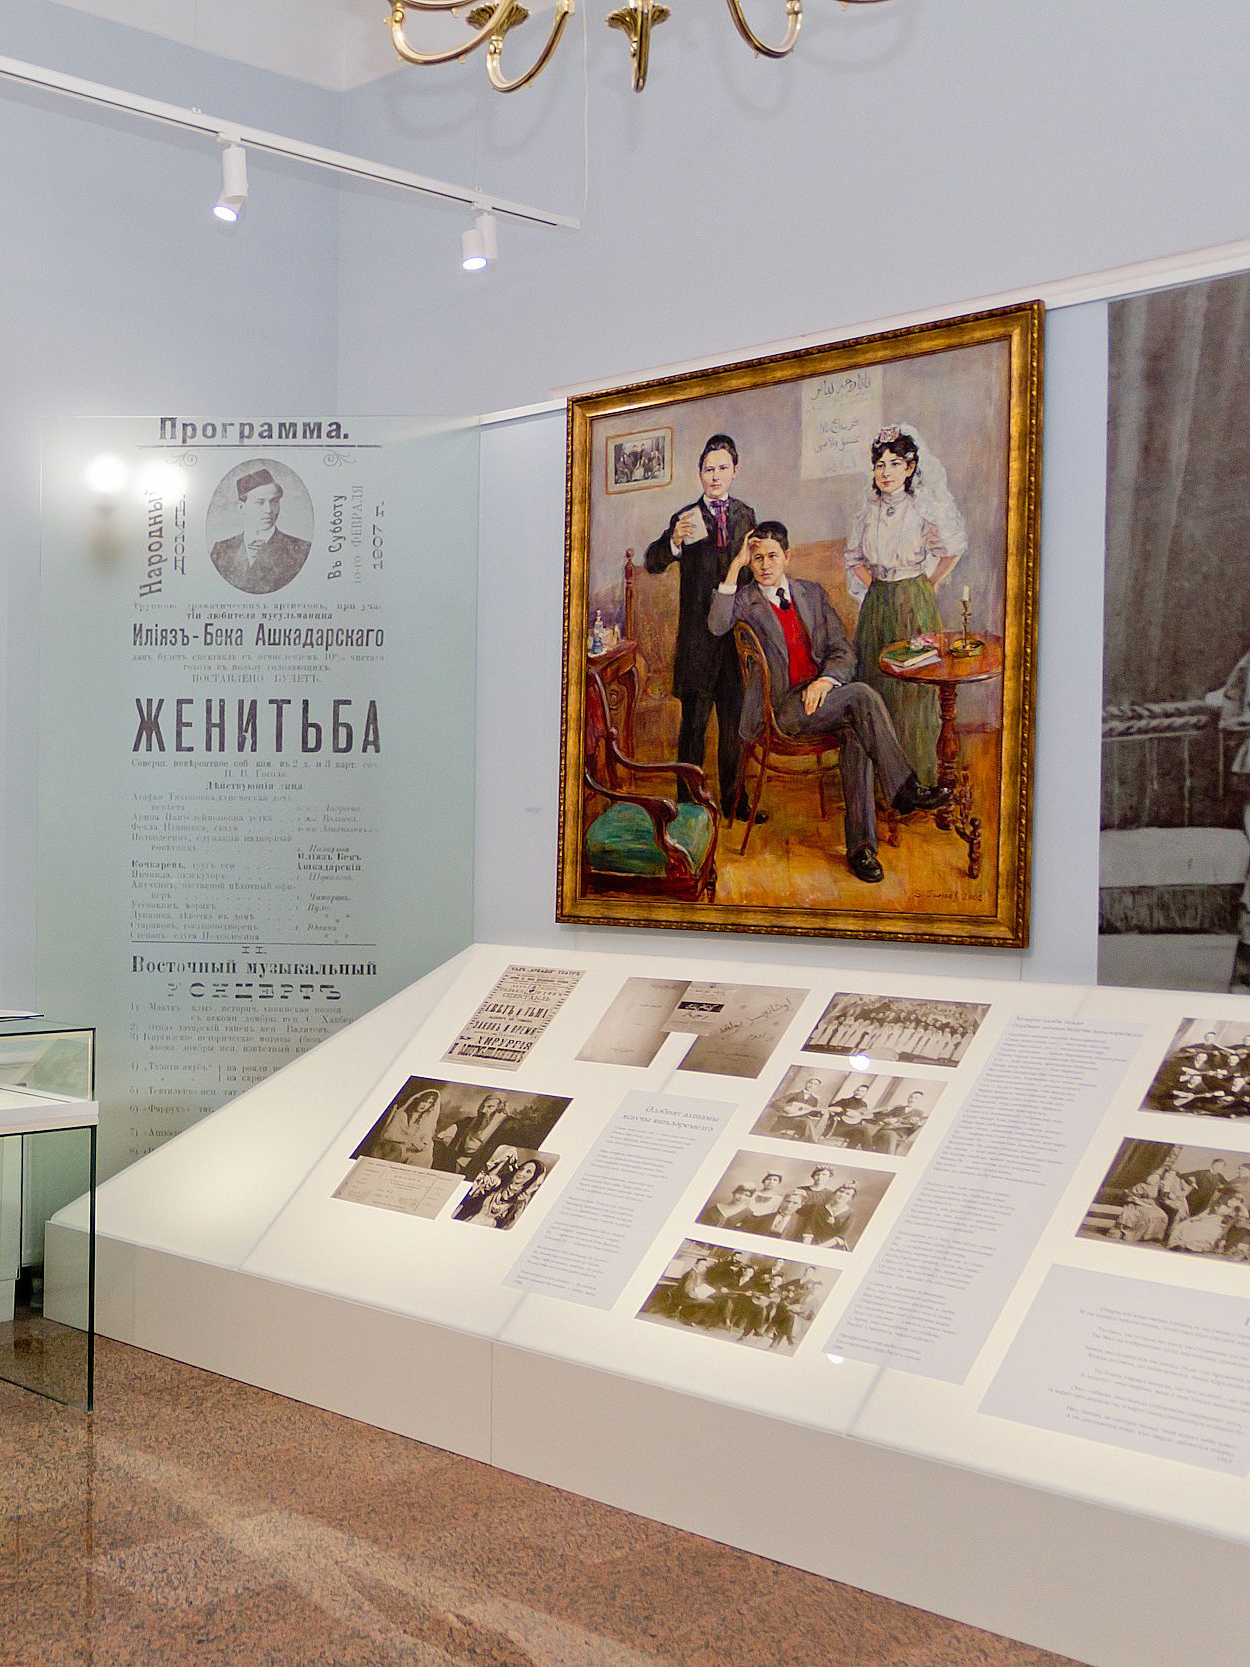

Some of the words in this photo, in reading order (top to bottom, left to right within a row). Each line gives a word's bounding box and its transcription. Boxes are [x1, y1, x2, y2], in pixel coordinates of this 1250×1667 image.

[159, 416, 350, 445] Программа.
[328, 494, 348, 553] Субботу
[351, 484, 364, 549] ФЕВРАЛЯ
[372, 523, 384, 570] 1907
[255, 622, 384, 652] Ашкадарскаго
[132, 698, 381, 754] ЖЕНИТЬБА
[131, 955, 238, 975] Восточный
[246, 961, 377, 978] музыкальный
